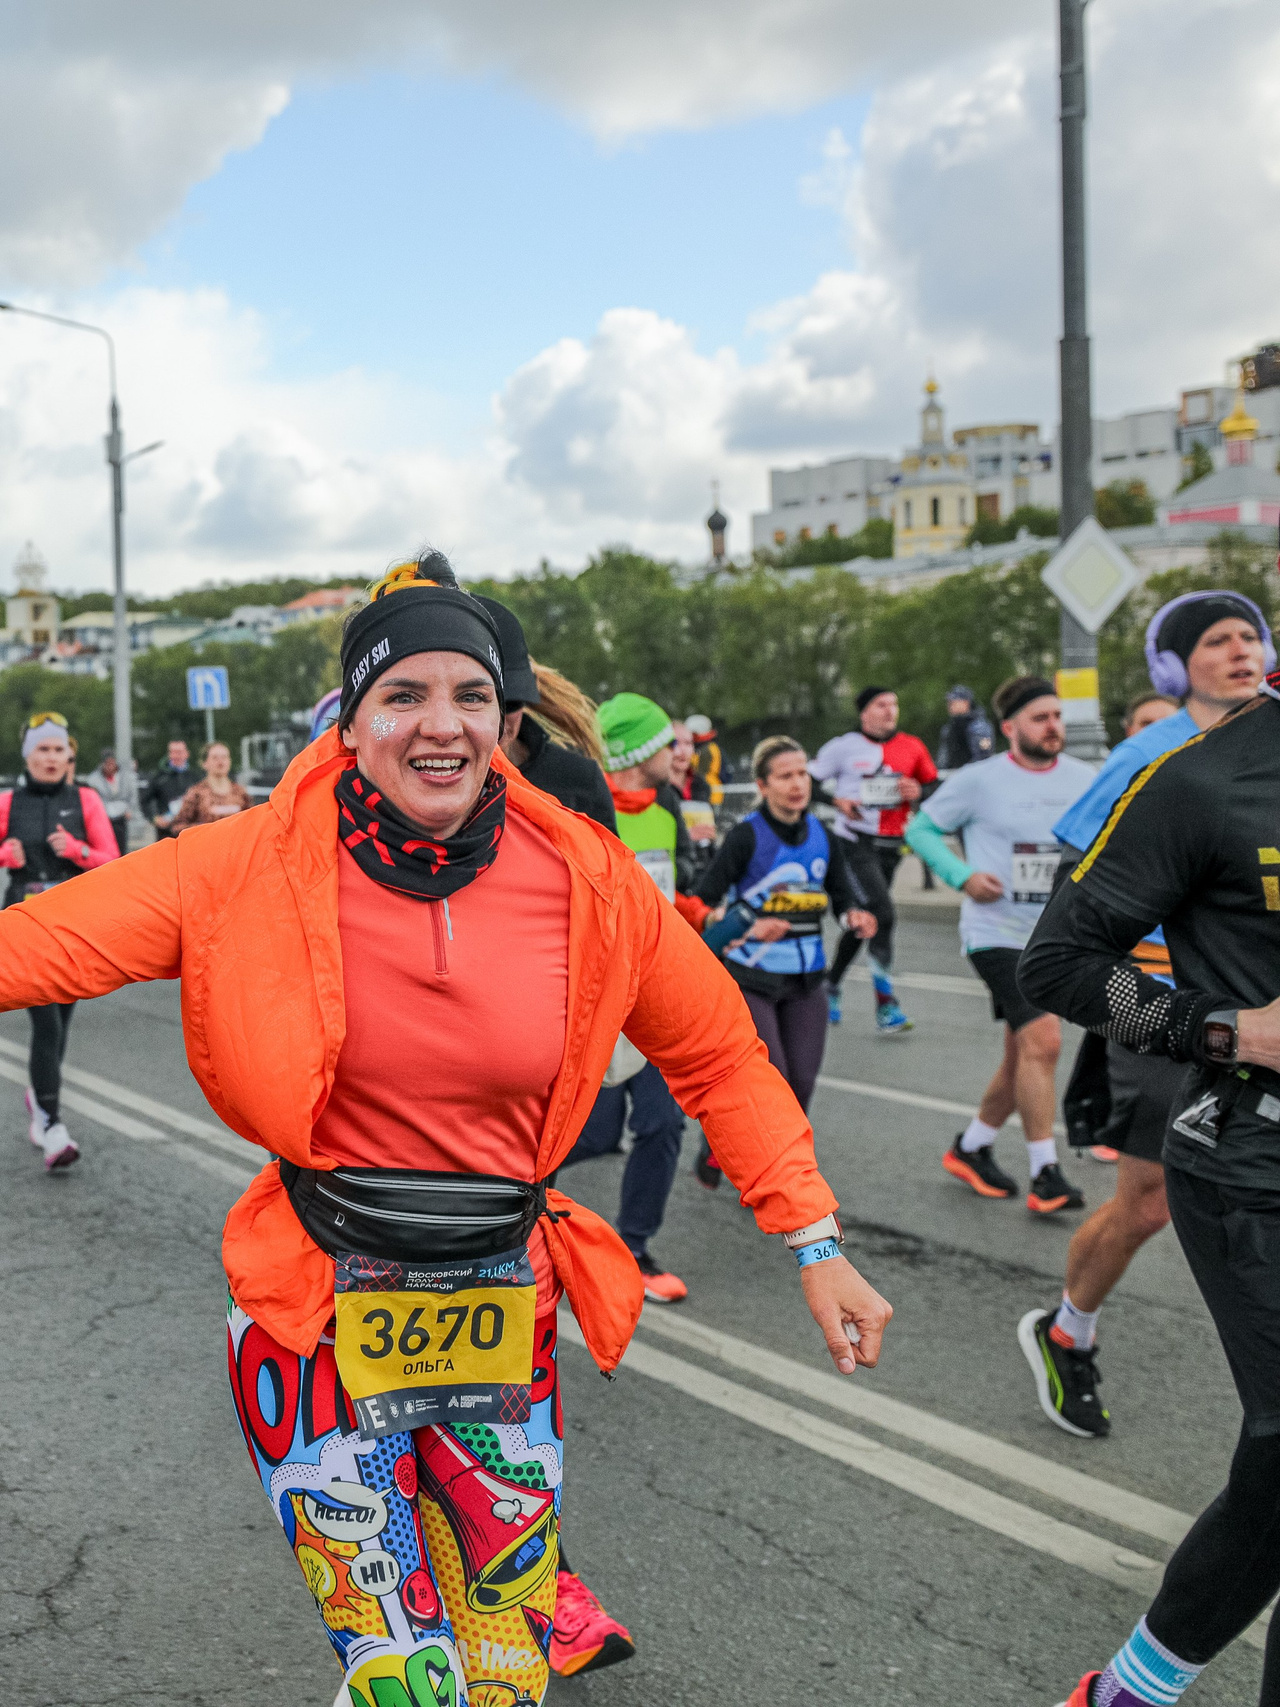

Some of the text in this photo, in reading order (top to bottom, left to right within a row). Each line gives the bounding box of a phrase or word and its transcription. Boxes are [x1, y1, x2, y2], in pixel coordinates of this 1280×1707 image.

[351, 637, 391, 692] EASY SKI
[408, 1267, 472, 1278] МОСКОВСКИЙ
[405, 1283, 453, 1291] МАРАФОН
[359, 1302, 505, 1360] 3670
[403, 1359, 455, 1375] ОЛЬГА
